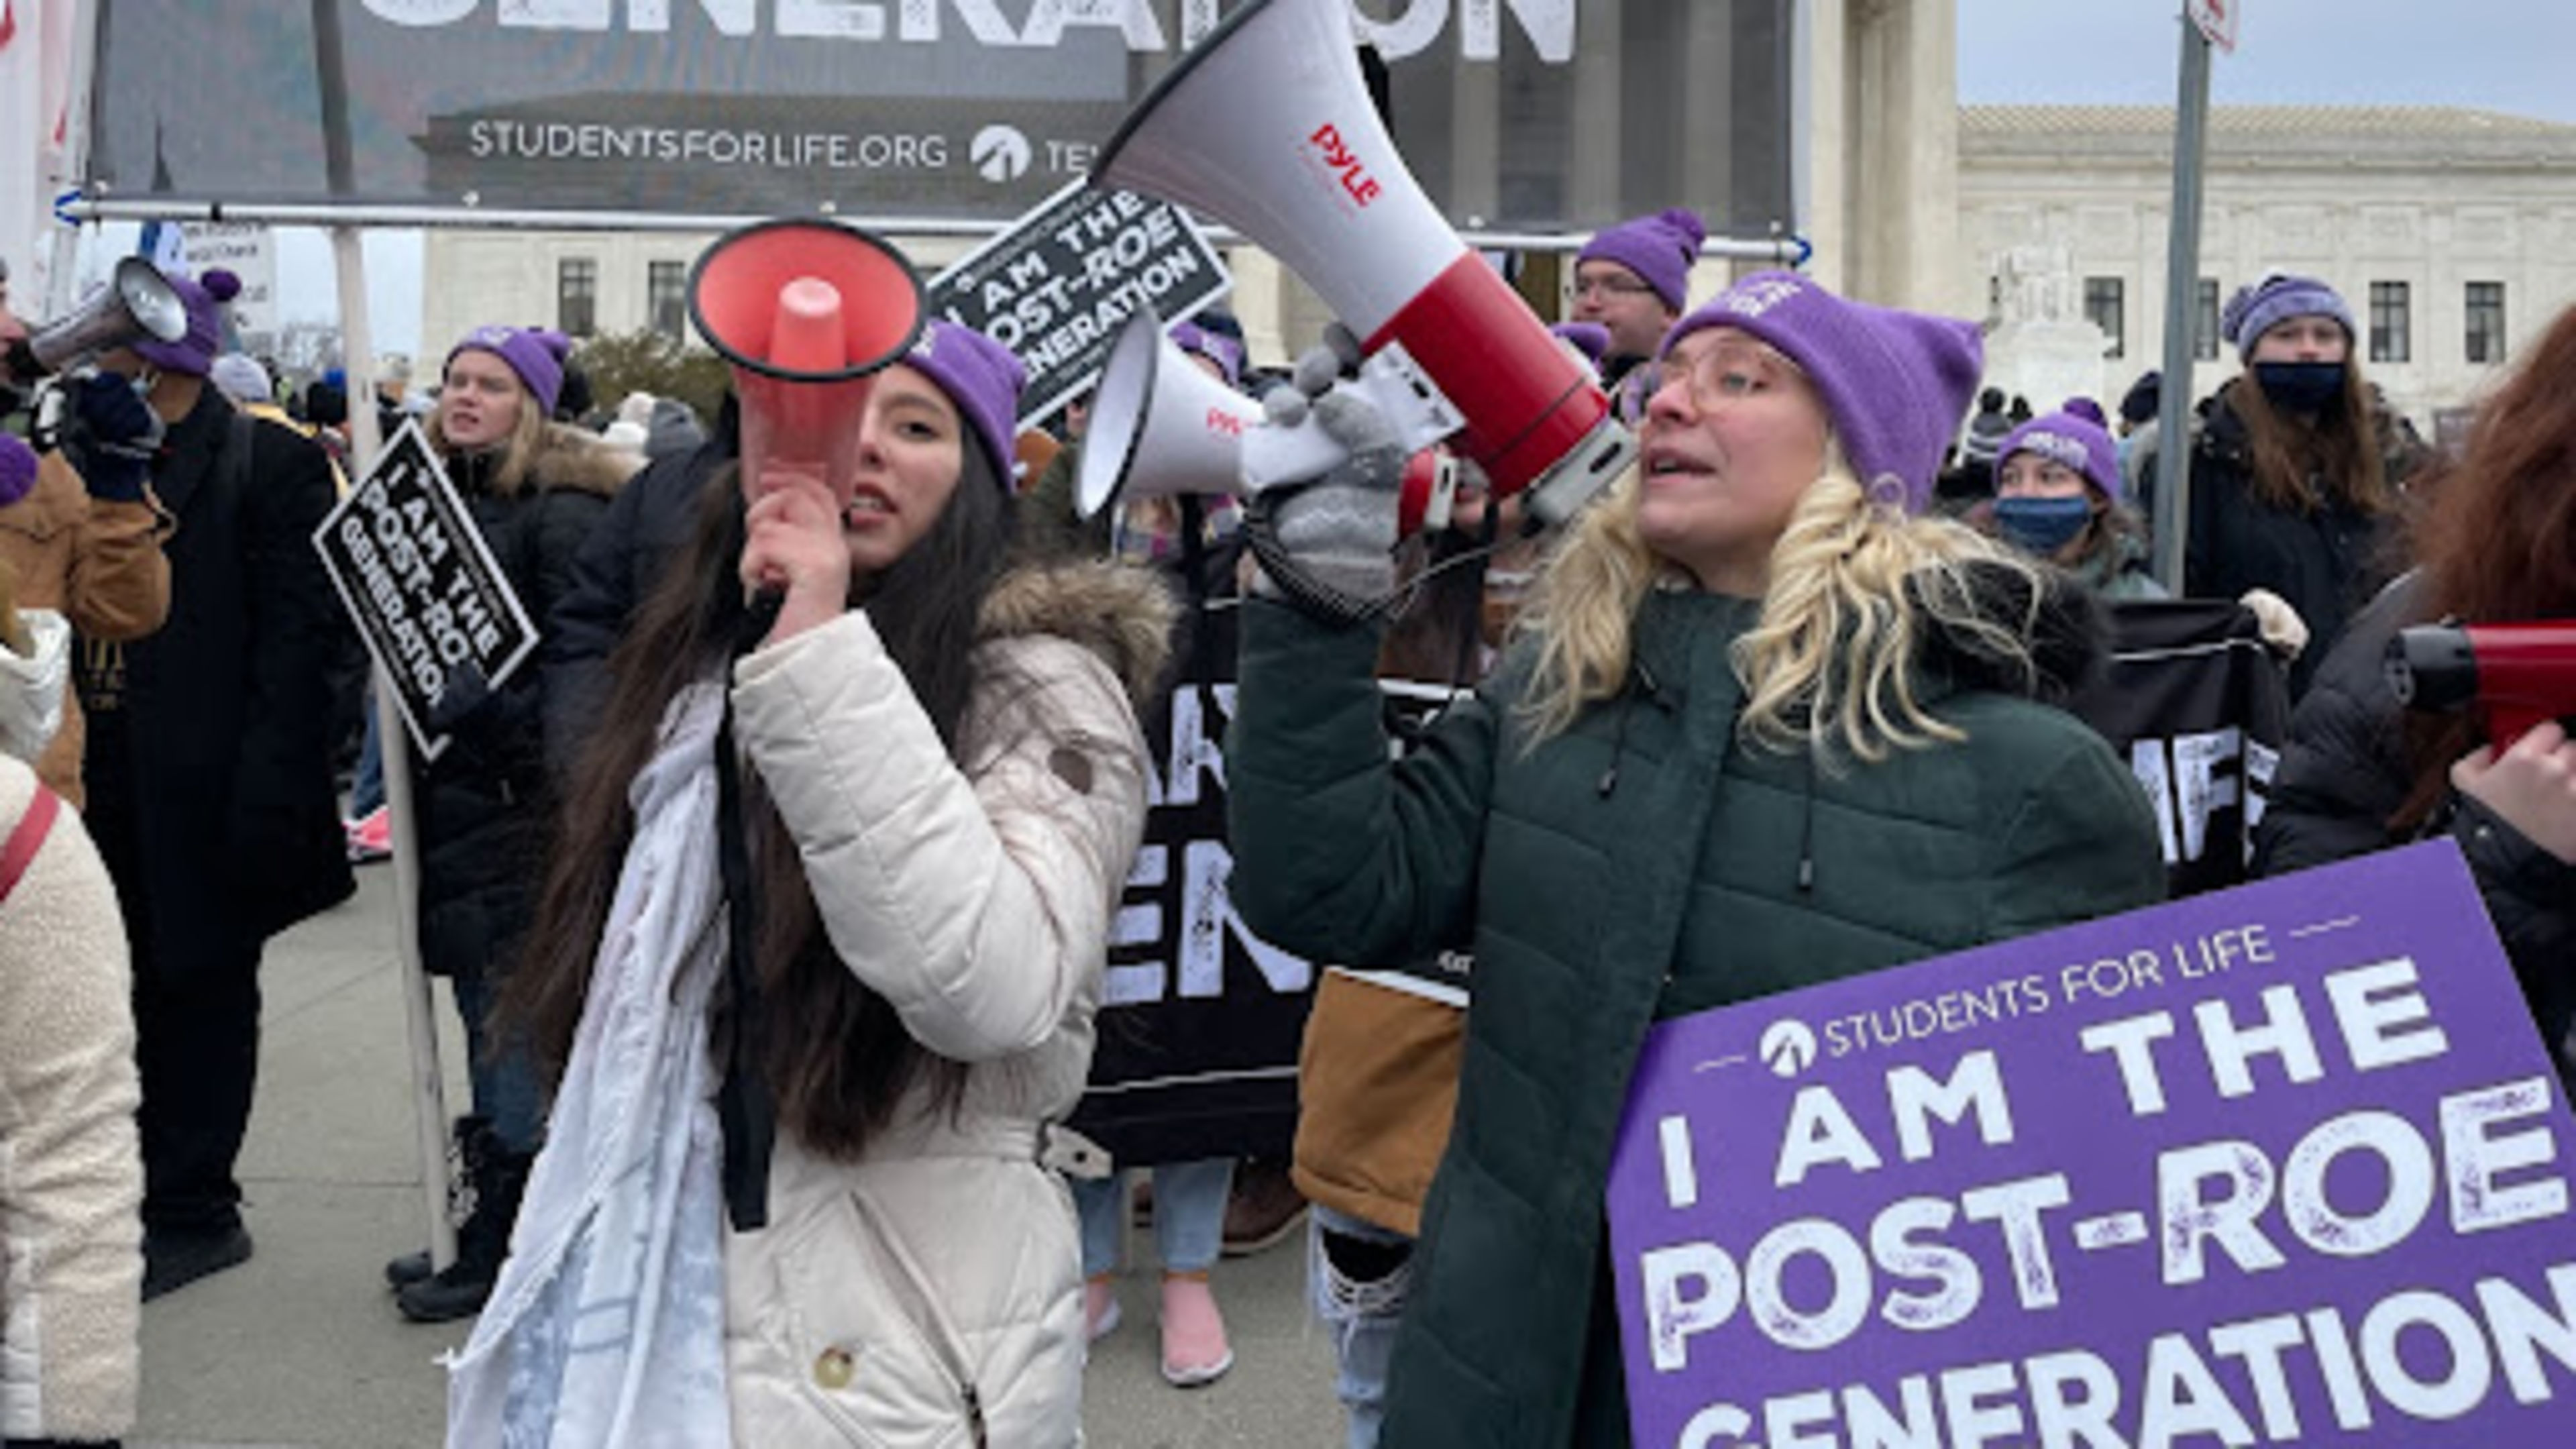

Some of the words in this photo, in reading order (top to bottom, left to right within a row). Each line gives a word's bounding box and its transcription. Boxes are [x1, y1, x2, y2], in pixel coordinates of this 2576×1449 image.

[470, 119, 947, 168] STUDENTSFORLIFE.ORG
[1311, 123, 1382, 207] PYLE
[984, 250, 1048, 313] AM
[1056, 191, 1143, 253] THE
[985, 204, 1179, 349] OST-ROE
[359, 478, 474, 665] POST-RO
[404, 496, 448, 565] AM
[447, 567, 502, 657] THE
[1825, 975, 2050, 1057] STUDENTS
[2060, 949, 2163, 1002] FOR
[2171, 924, 2275, 979] LIFE
[1658, 1116, 1697, 1208] I
[1774, 1051, 2015, 1187] AM
[2080, 956, 2448, 1116] THE
[1642, 1075, 2569, 1373] POST-ROE
